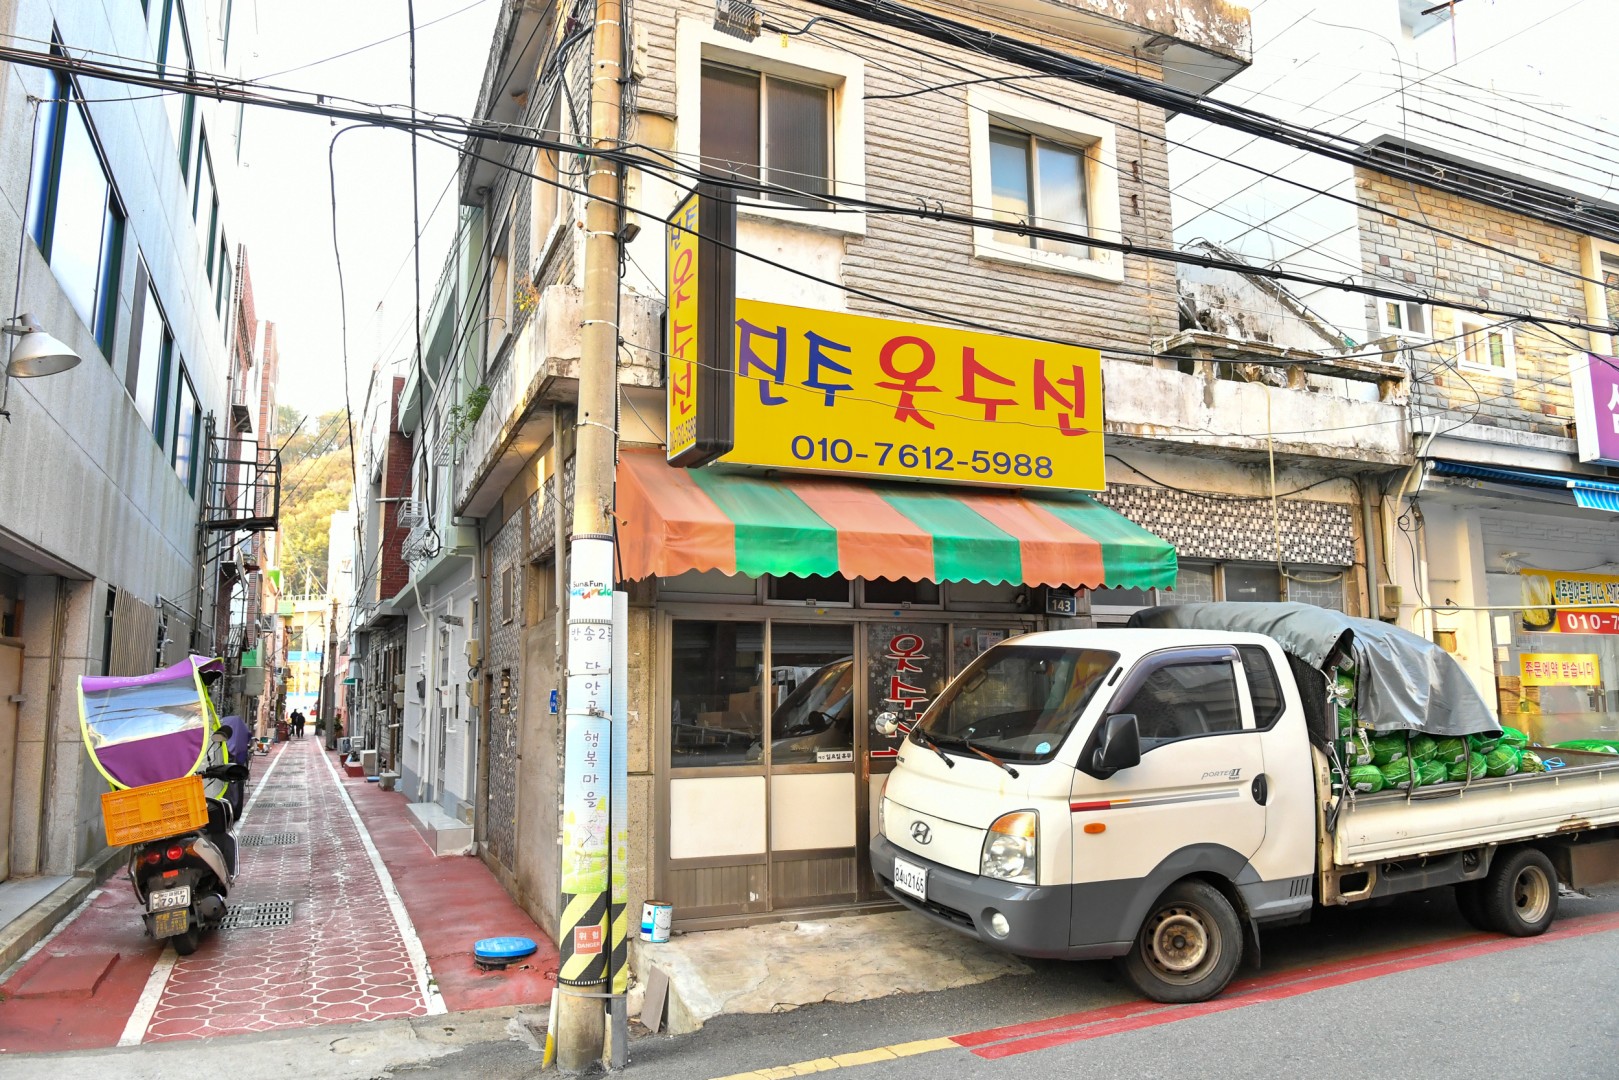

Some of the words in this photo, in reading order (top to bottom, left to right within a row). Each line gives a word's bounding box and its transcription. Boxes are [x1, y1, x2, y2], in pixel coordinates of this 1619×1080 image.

[673, 248, 695, 416] 옷수선
[875, 335, 1091, 437] 옷수선
[791, 435, 1053, 479] 010-7612-5988
[573, 580, 604, 588] Sun&Fun
[1051, 599, 1071, 612] 143
[1567, 613, 1619, 630] 010-7
[1525, 661, 1558, 679] 주문예약
[1562, 661, 1594, 679] 받습니다
[582, 730, 600, 808] 행복마을
[162, 894, 186, 907] 7917
[577, 941, 600, 949] DANGER
